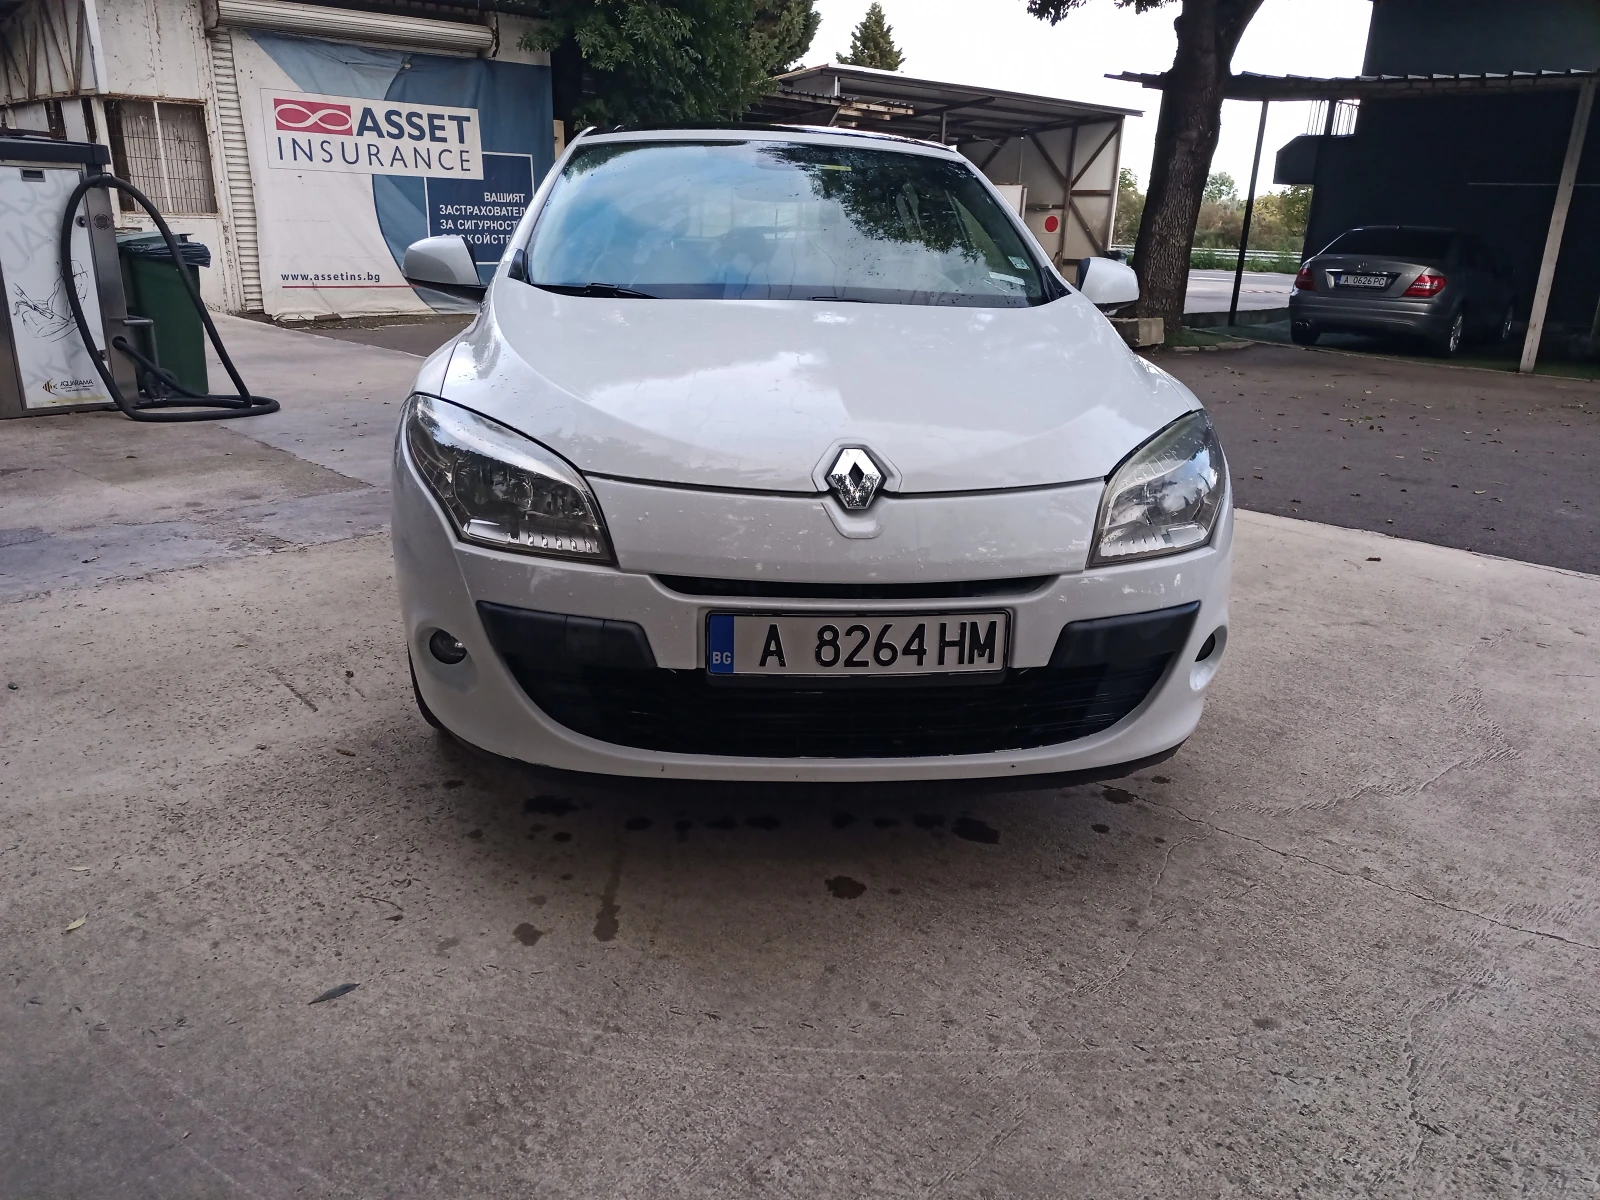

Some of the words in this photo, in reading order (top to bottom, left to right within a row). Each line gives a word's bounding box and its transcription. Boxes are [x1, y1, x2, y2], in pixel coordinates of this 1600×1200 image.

[356, 107, 471, 144] ASSET
[278, 137, 471, 172] INSURANCE
[484, 192, 526, 203] ВАШИЯТ
[440, 219, 454, 229] ЗА
[281, 272, 381, 283] www.assetins.bg
[1343, 275, 1349, 284] A
[759, 624, 787, 667] A
[815, 624, 928, 668] 8264
[937, 621, 997, 666] HM
[712, 651, 732, 664] BG
